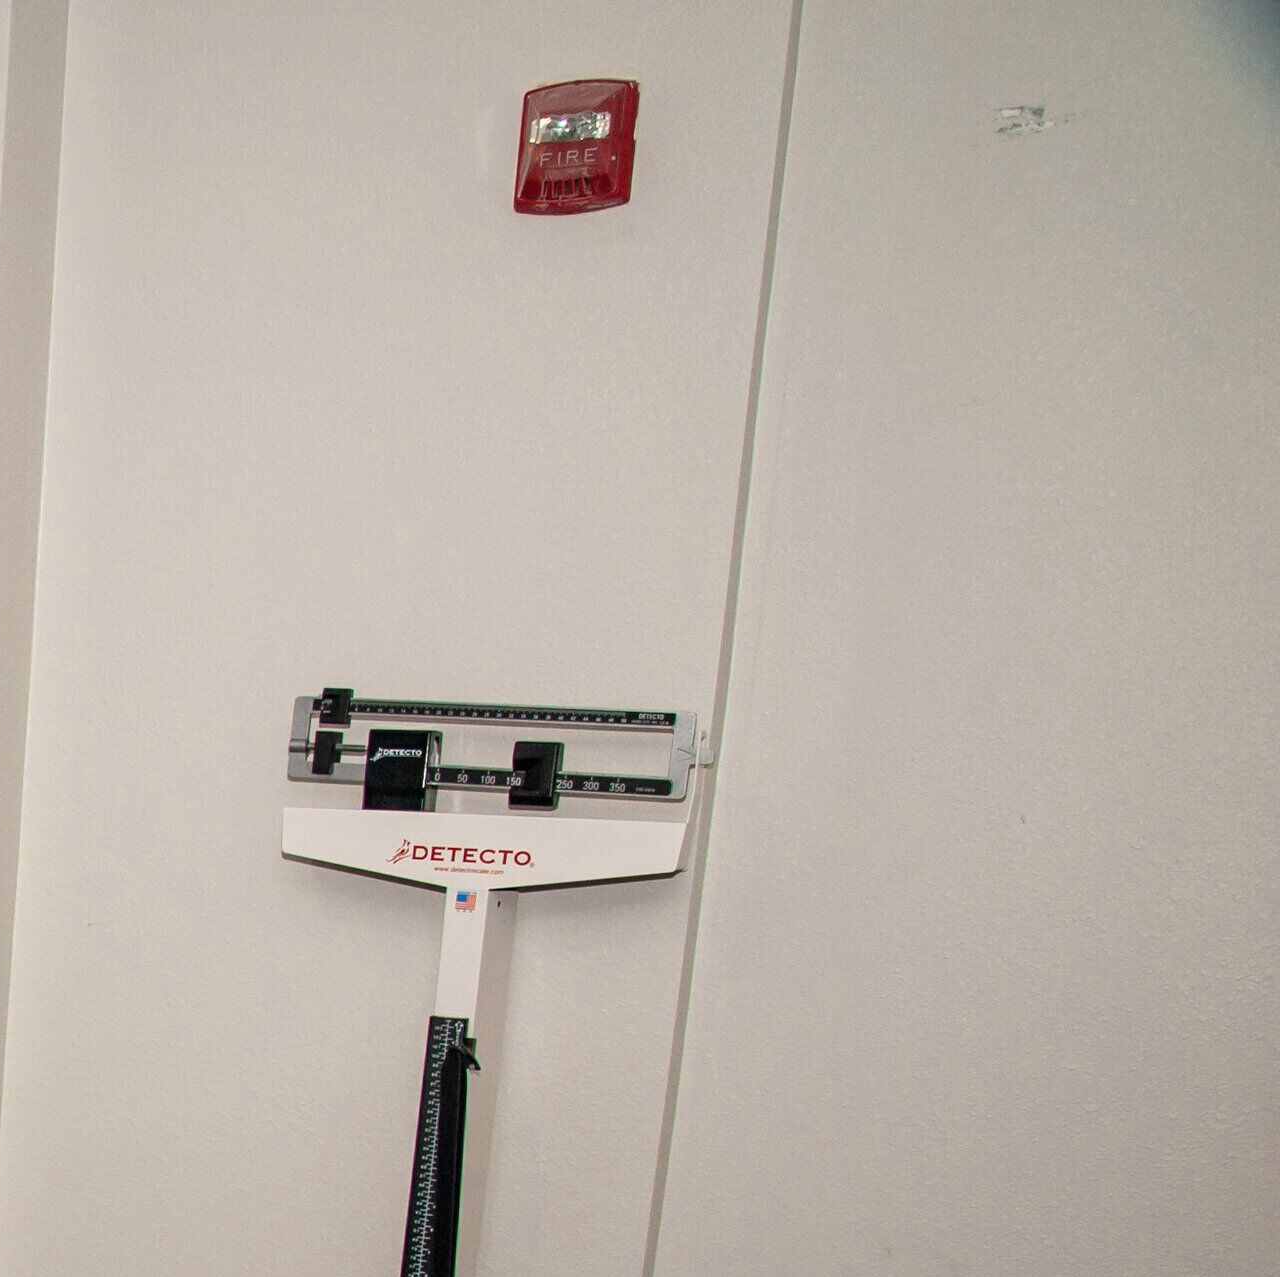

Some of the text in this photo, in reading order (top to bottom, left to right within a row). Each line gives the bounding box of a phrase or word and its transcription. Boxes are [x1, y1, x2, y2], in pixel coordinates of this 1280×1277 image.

[539, 147, 598, 167] FIRE
[434, 772, 441, 782] 0
[457, 773, 468, 783] 50
[480, 775, 496, 784] 100
[506, 776, 521, 786] 150
[556, 779, 574, 790] 250
[582, 781, 600, 791] 300
[609, 782, 626, 793] 350
[412, 845, 531, 866] DETECTO
